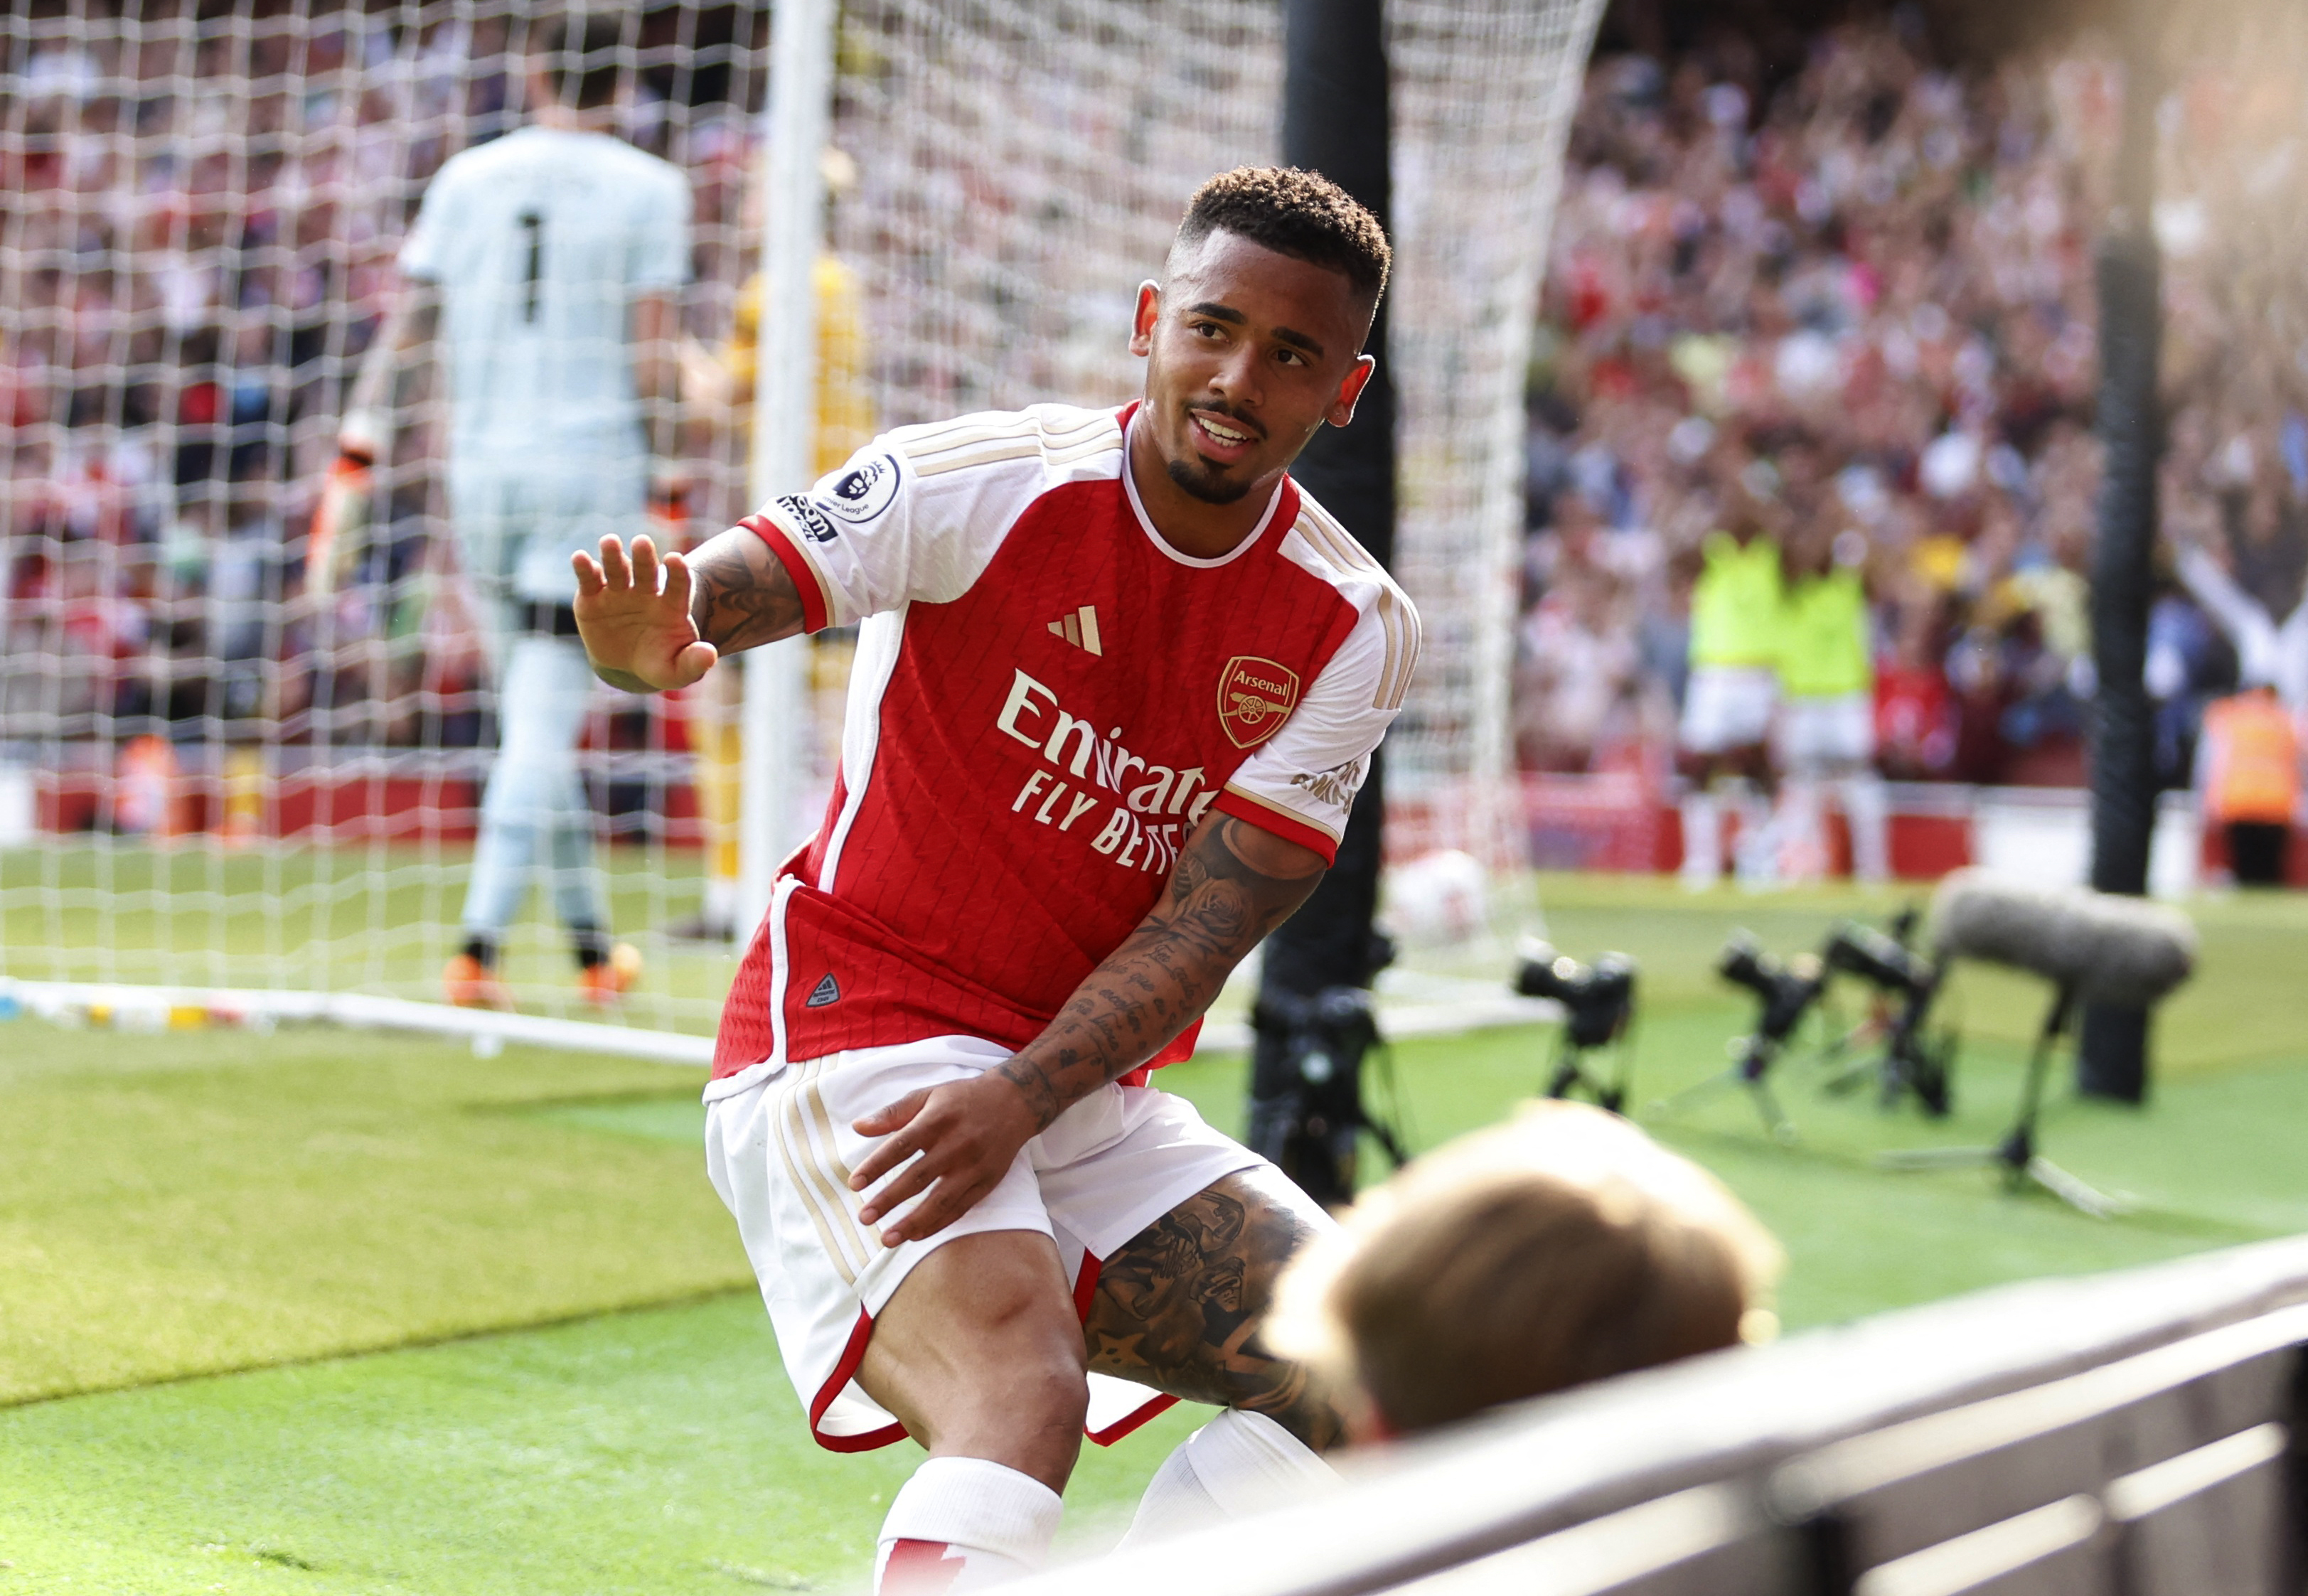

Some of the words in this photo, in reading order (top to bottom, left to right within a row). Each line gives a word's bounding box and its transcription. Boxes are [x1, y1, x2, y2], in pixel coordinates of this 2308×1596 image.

[517, 210, 543, 323] 1
[841, 503, 869, 515] League
[1234, 670, 1288, 697] Arsenal
[997, 667, 1220, 828] Emirate
[1011, 768, 1099, 832] FLY
[1091, 807, 1194, 875] BETTE
